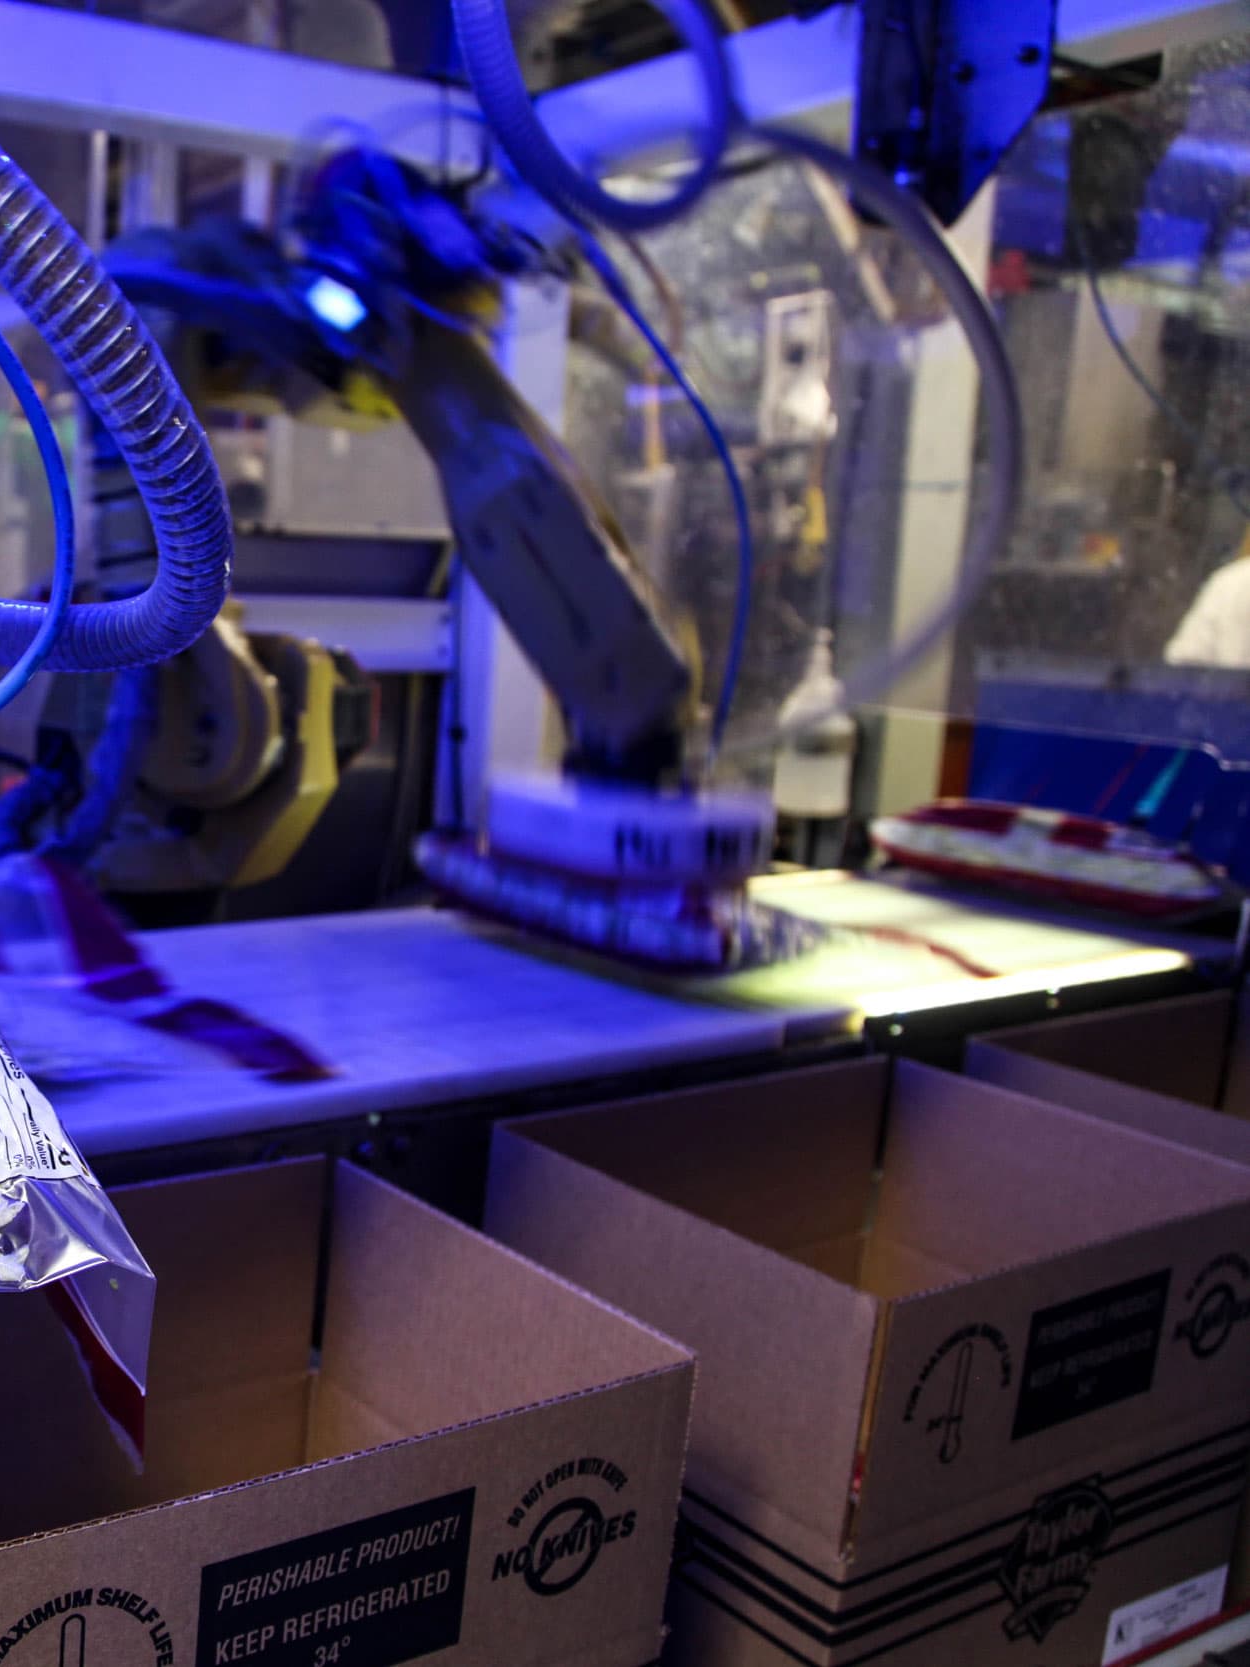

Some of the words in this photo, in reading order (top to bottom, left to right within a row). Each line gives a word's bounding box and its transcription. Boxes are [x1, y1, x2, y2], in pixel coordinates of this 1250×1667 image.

[507, 1507, 525, 1527] DO
[522, 1480, 545, 1508] NOT
[544, 1461, 575, 1489] OPEN
[577, 1457, 606, 1476] WITH
[216, 1546, 354, 1612] PERISHABLE
[355, 1513, 462, 1570] PRODUCT!
[491, 1546, 532, 1582] NO
[540, 1508, 638, 1567] KNIVES
[96, 1587, 161, 1624] SHELF
[149, 1621, 174, 1667] LIFE
[215, 1624, 276, 1666] KEEP
[281, 1568, 452, 1644] REFRIGERATED
